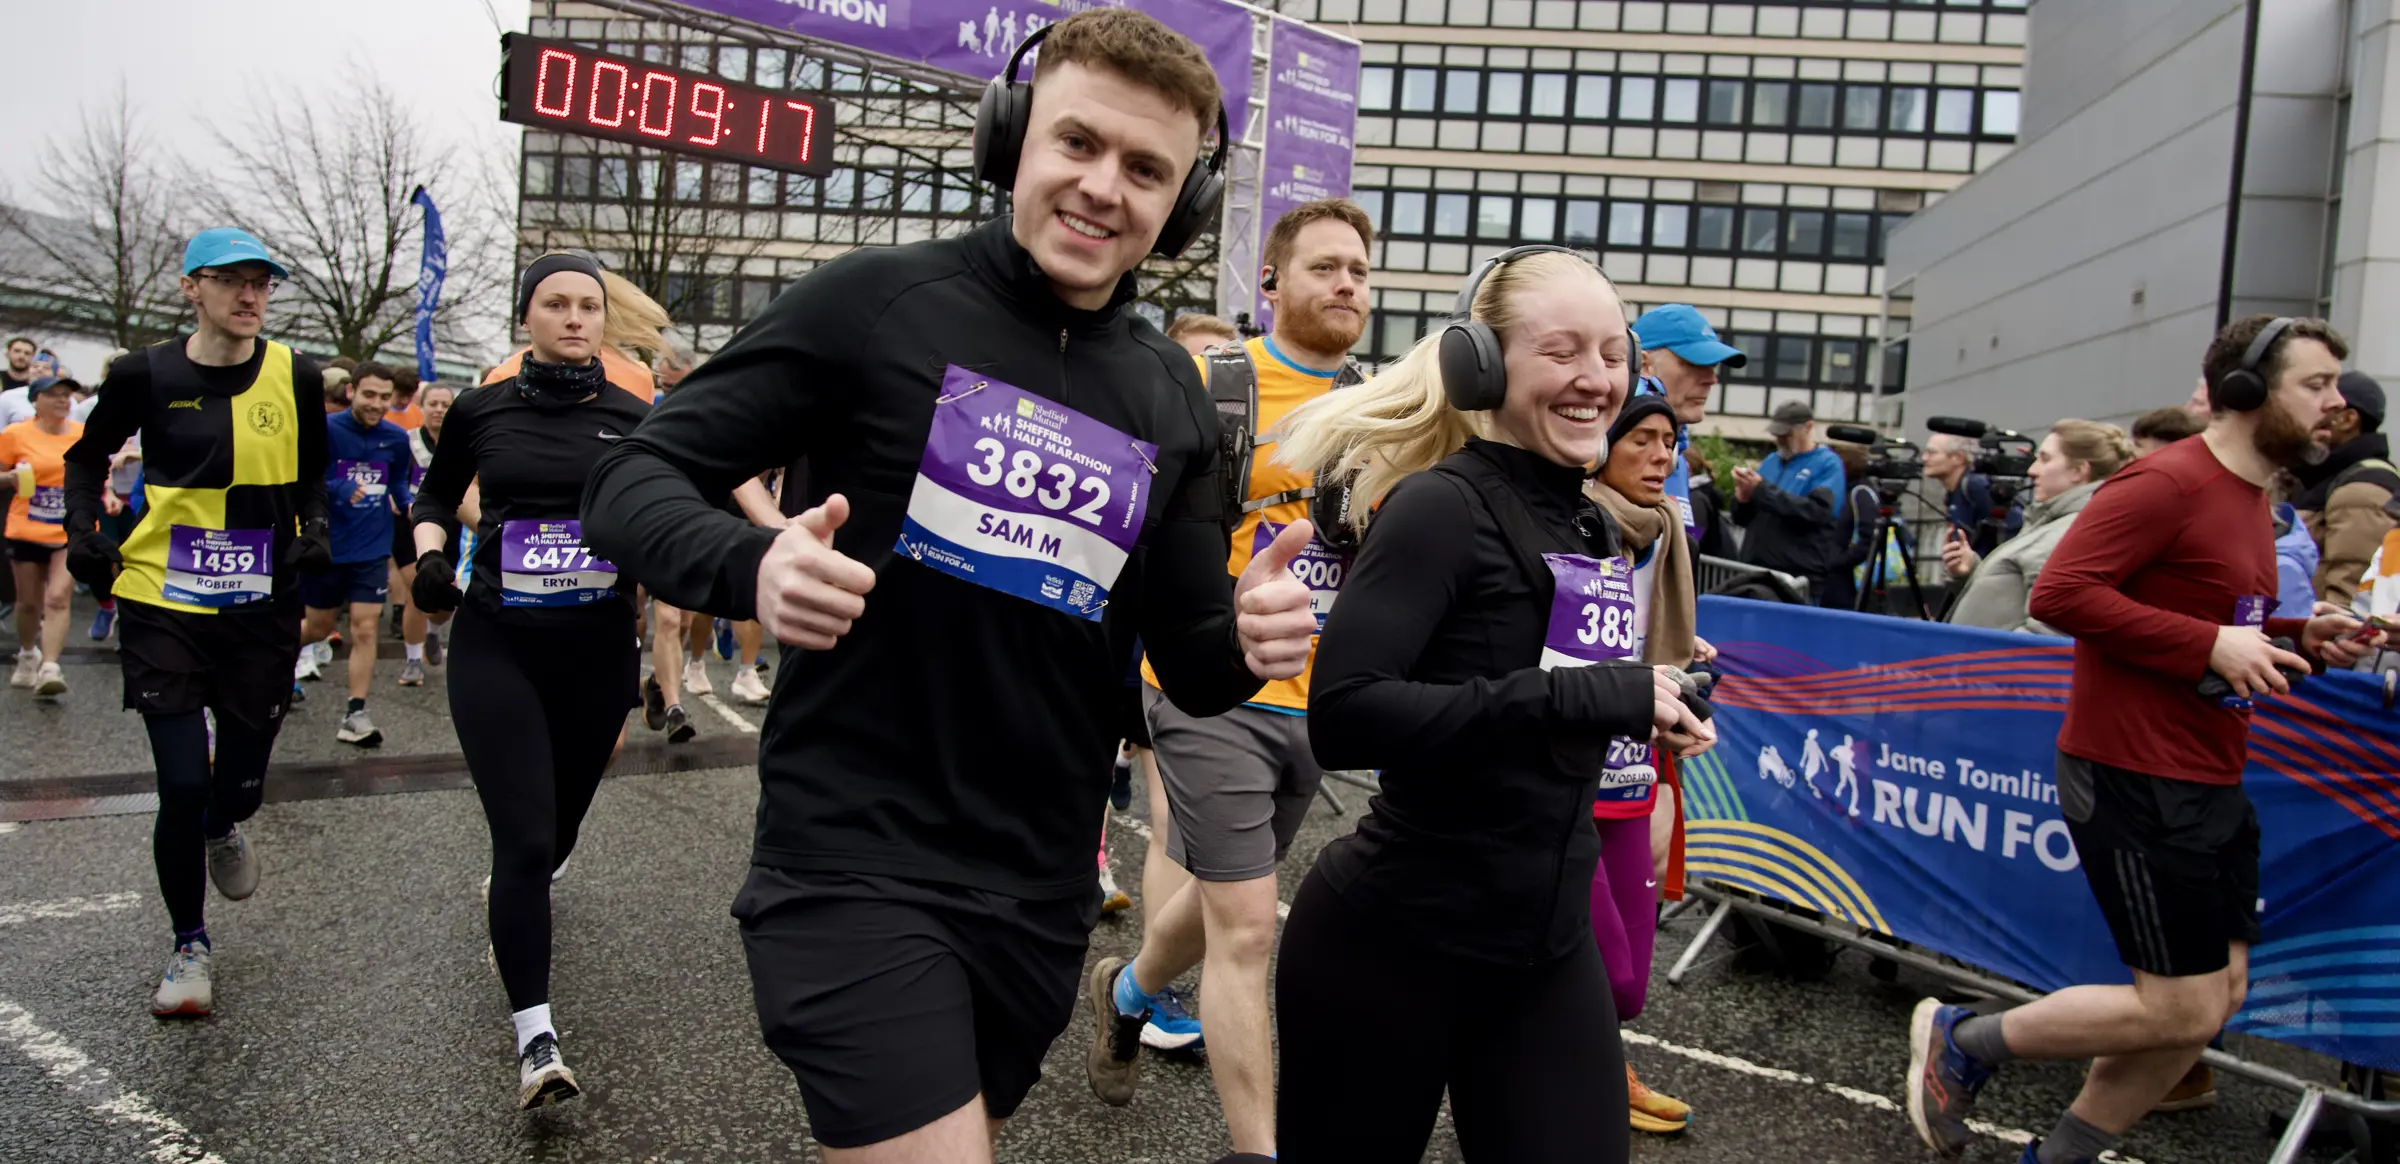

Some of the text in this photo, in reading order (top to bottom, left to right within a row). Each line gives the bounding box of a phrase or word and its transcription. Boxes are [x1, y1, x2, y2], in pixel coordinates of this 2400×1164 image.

[535, 48, 815, 162] 00:09:17
[1032, 413, 1063, 430] Mutual
[1034, 403, 1069, 425] Sheffield
[1015, 417, 1073, 447] SHEFFIELD
[1012, 429, 1112, 476] HALF MARATHON
[966, 437, 1111, 526] 3832
[1122, 502, 1135, 528] SAMUEL
[1338, 486, 1350, 524] AONIJIE
[976, 512, 1062, 558] SAM M
[192, 549, 255, 573] 1459
[522, 547, 594, 569] 6477
[927, 549, 975, 573] RUN FOR ALL
[196, 577, 243, 590] ROBERT
[542, 578, 578, 587] ERYN
[1293, 558, 1342, 588] 900
[1309, 599, 1318, 609] H
[1602, 590, 1619, 599] HALF
[1576, 602, 1633, 650] 383
[1876, 742, 2060, 806] Jane Tomlin
[1871, 778, 2081, 873] RUN FO
